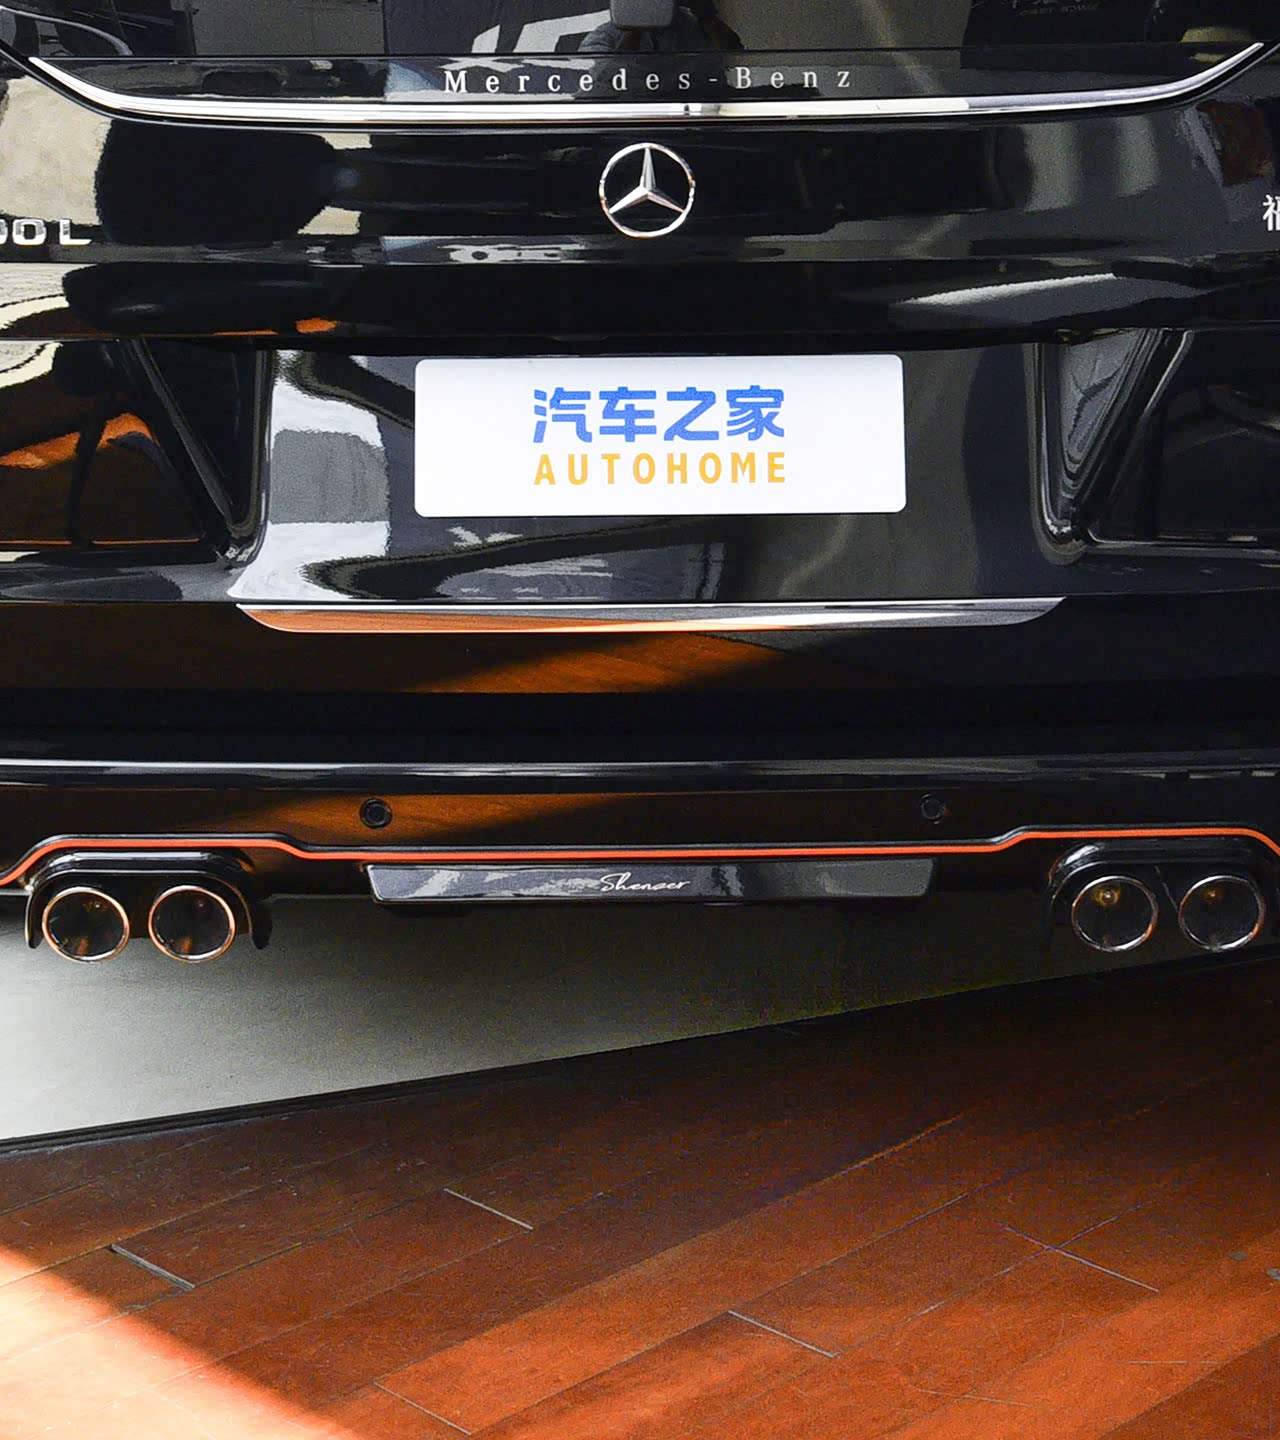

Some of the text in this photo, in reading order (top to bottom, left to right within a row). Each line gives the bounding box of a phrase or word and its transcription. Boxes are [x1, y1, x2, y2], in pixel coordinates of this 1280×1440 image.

[443, 67, 851, 93] Mercedes-Benz
[533, 385, 785, 442] 汽车之家
[534, 452, 785, 485] AUTOHOME
